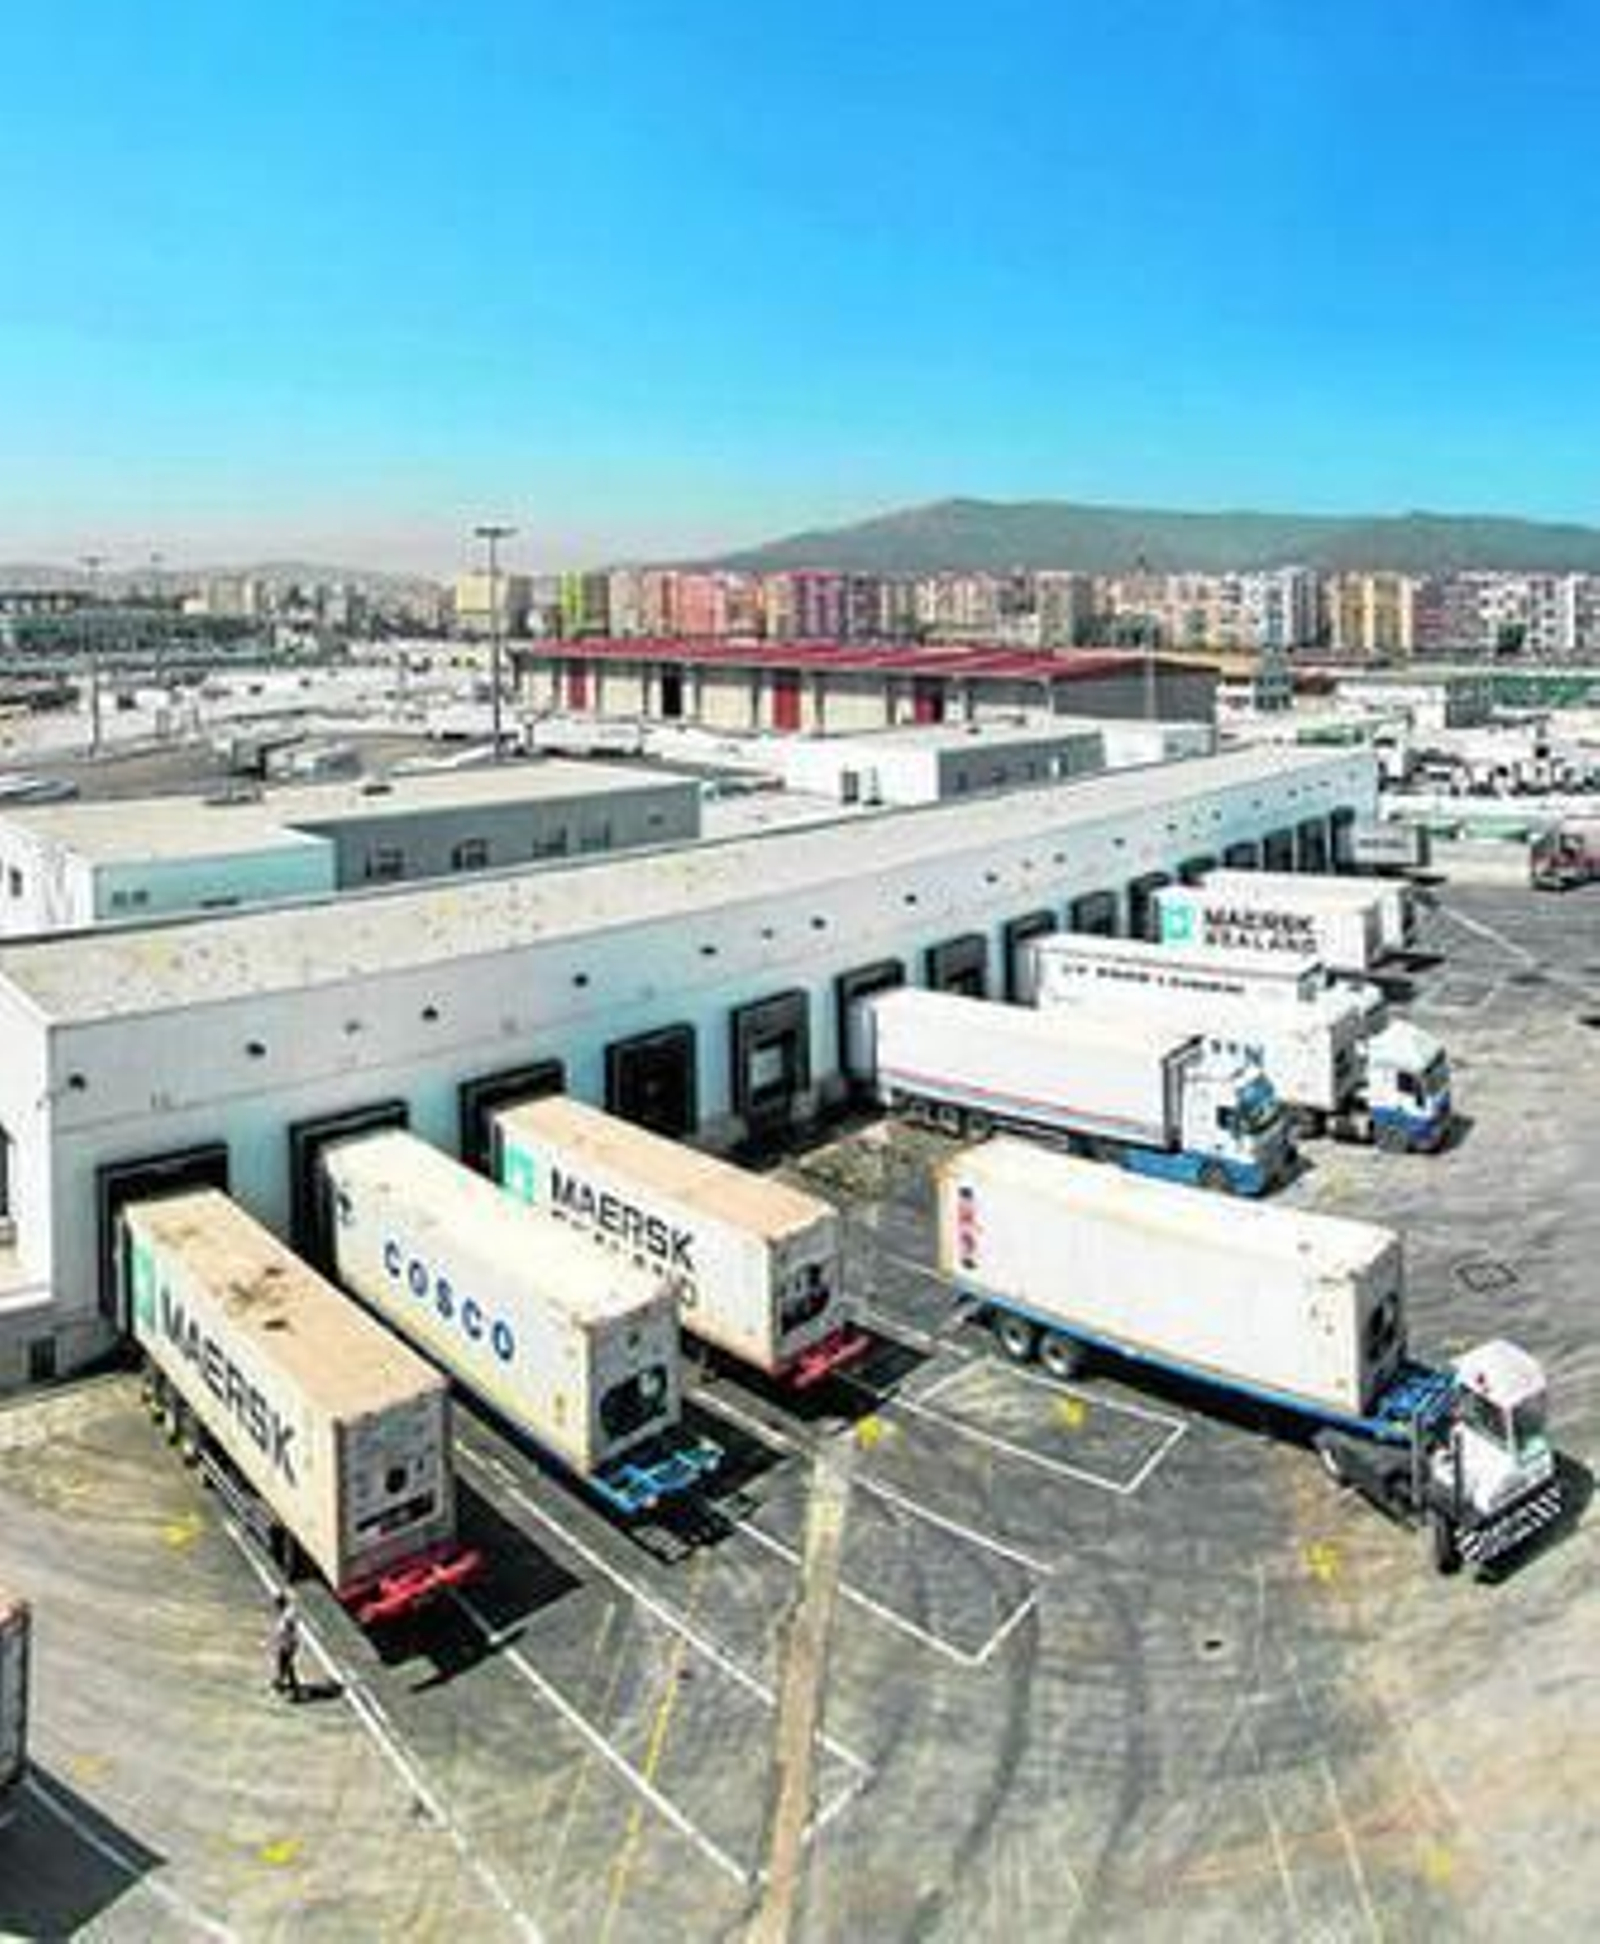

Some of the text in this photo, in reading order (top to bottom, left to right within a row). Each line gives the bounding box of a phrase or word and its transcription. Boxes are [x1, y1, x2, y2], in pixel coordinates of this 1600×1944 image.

[1203, 906, 1317, 935] MAERSK
[551, 1167, 695, 1272] MAERSK
[384, 1239, 516, 1362] COSCO
[161, 1287, 297, 1487] MAERSK
